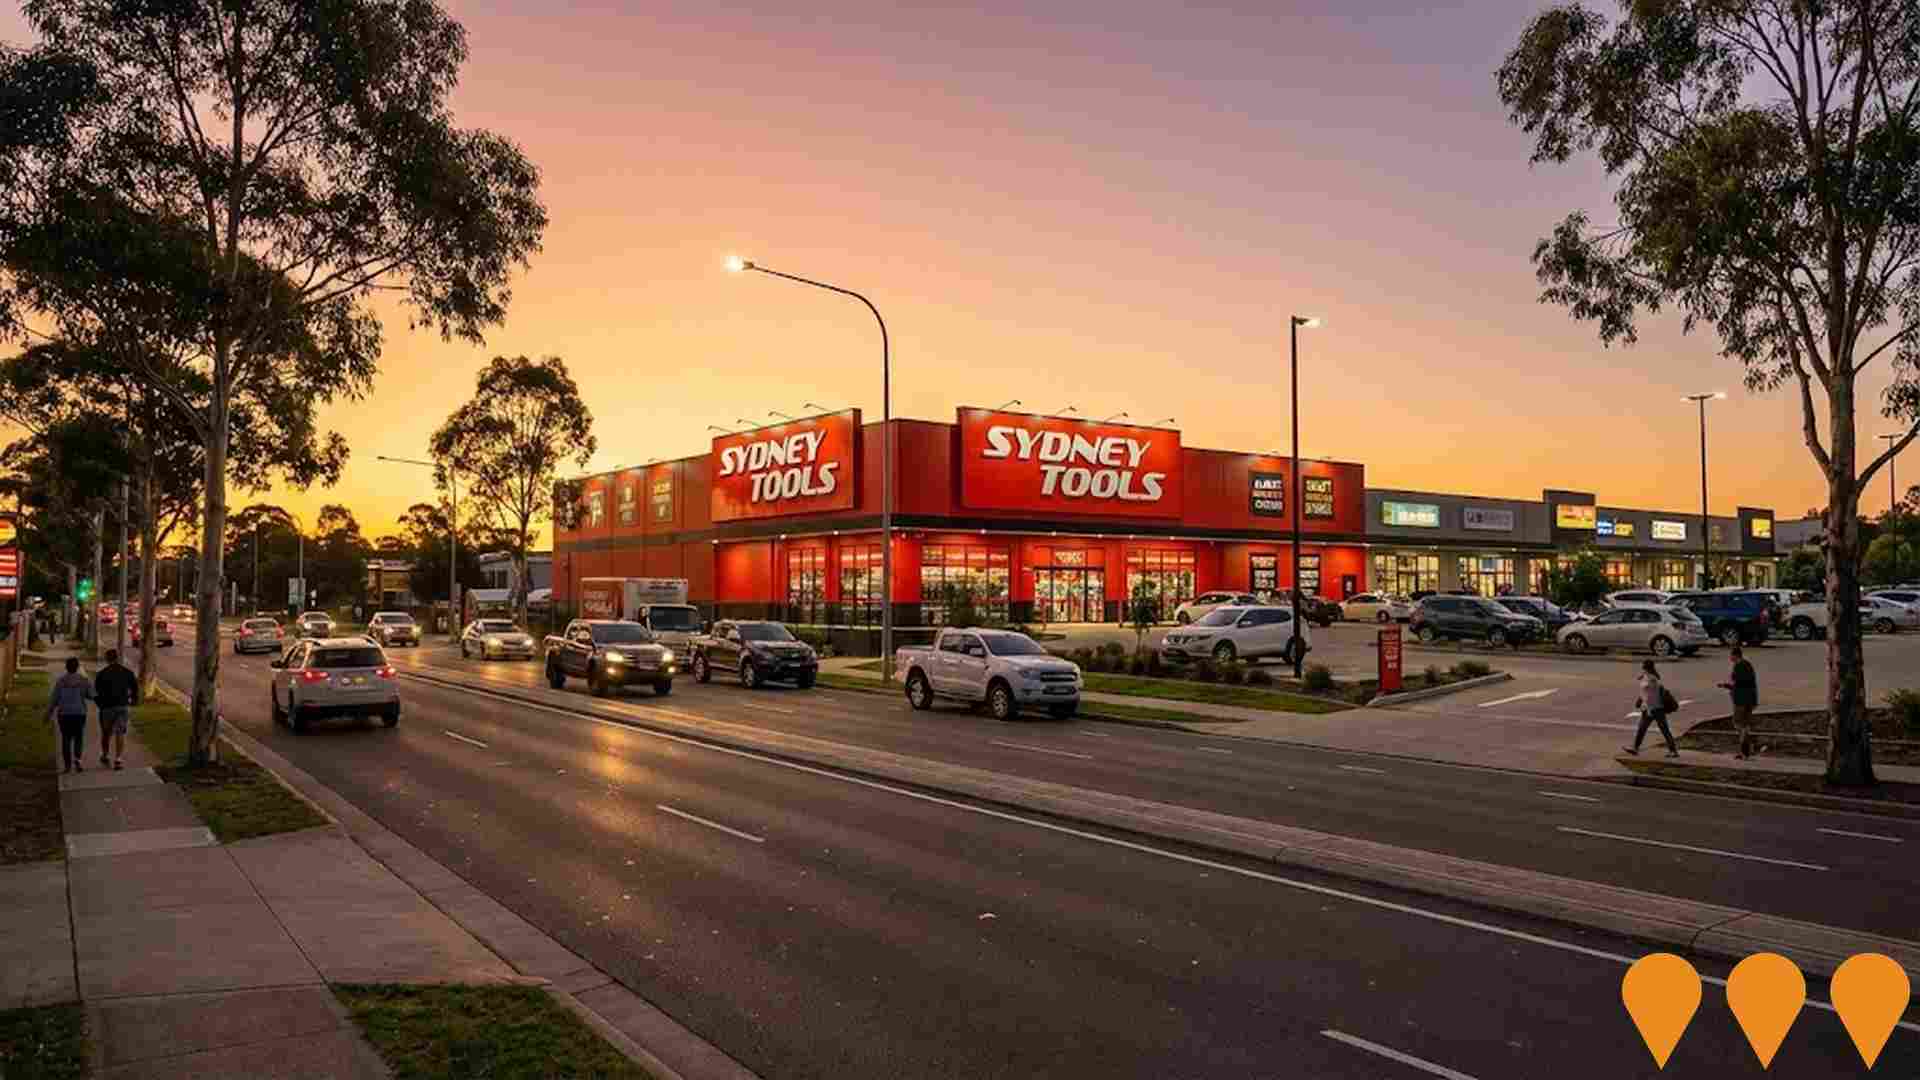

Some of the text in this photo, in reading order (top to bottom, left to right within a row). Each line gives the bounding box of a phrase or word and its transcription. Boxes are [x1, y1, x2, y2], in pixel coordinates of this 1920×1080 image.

[719, 429, 827, 476] SYDNEY
[983, 425, 1152, 468] SYDNEY
[751, 461, 839, 502] TOOLS
[1040, 464, 1166, 500] TOOLS
